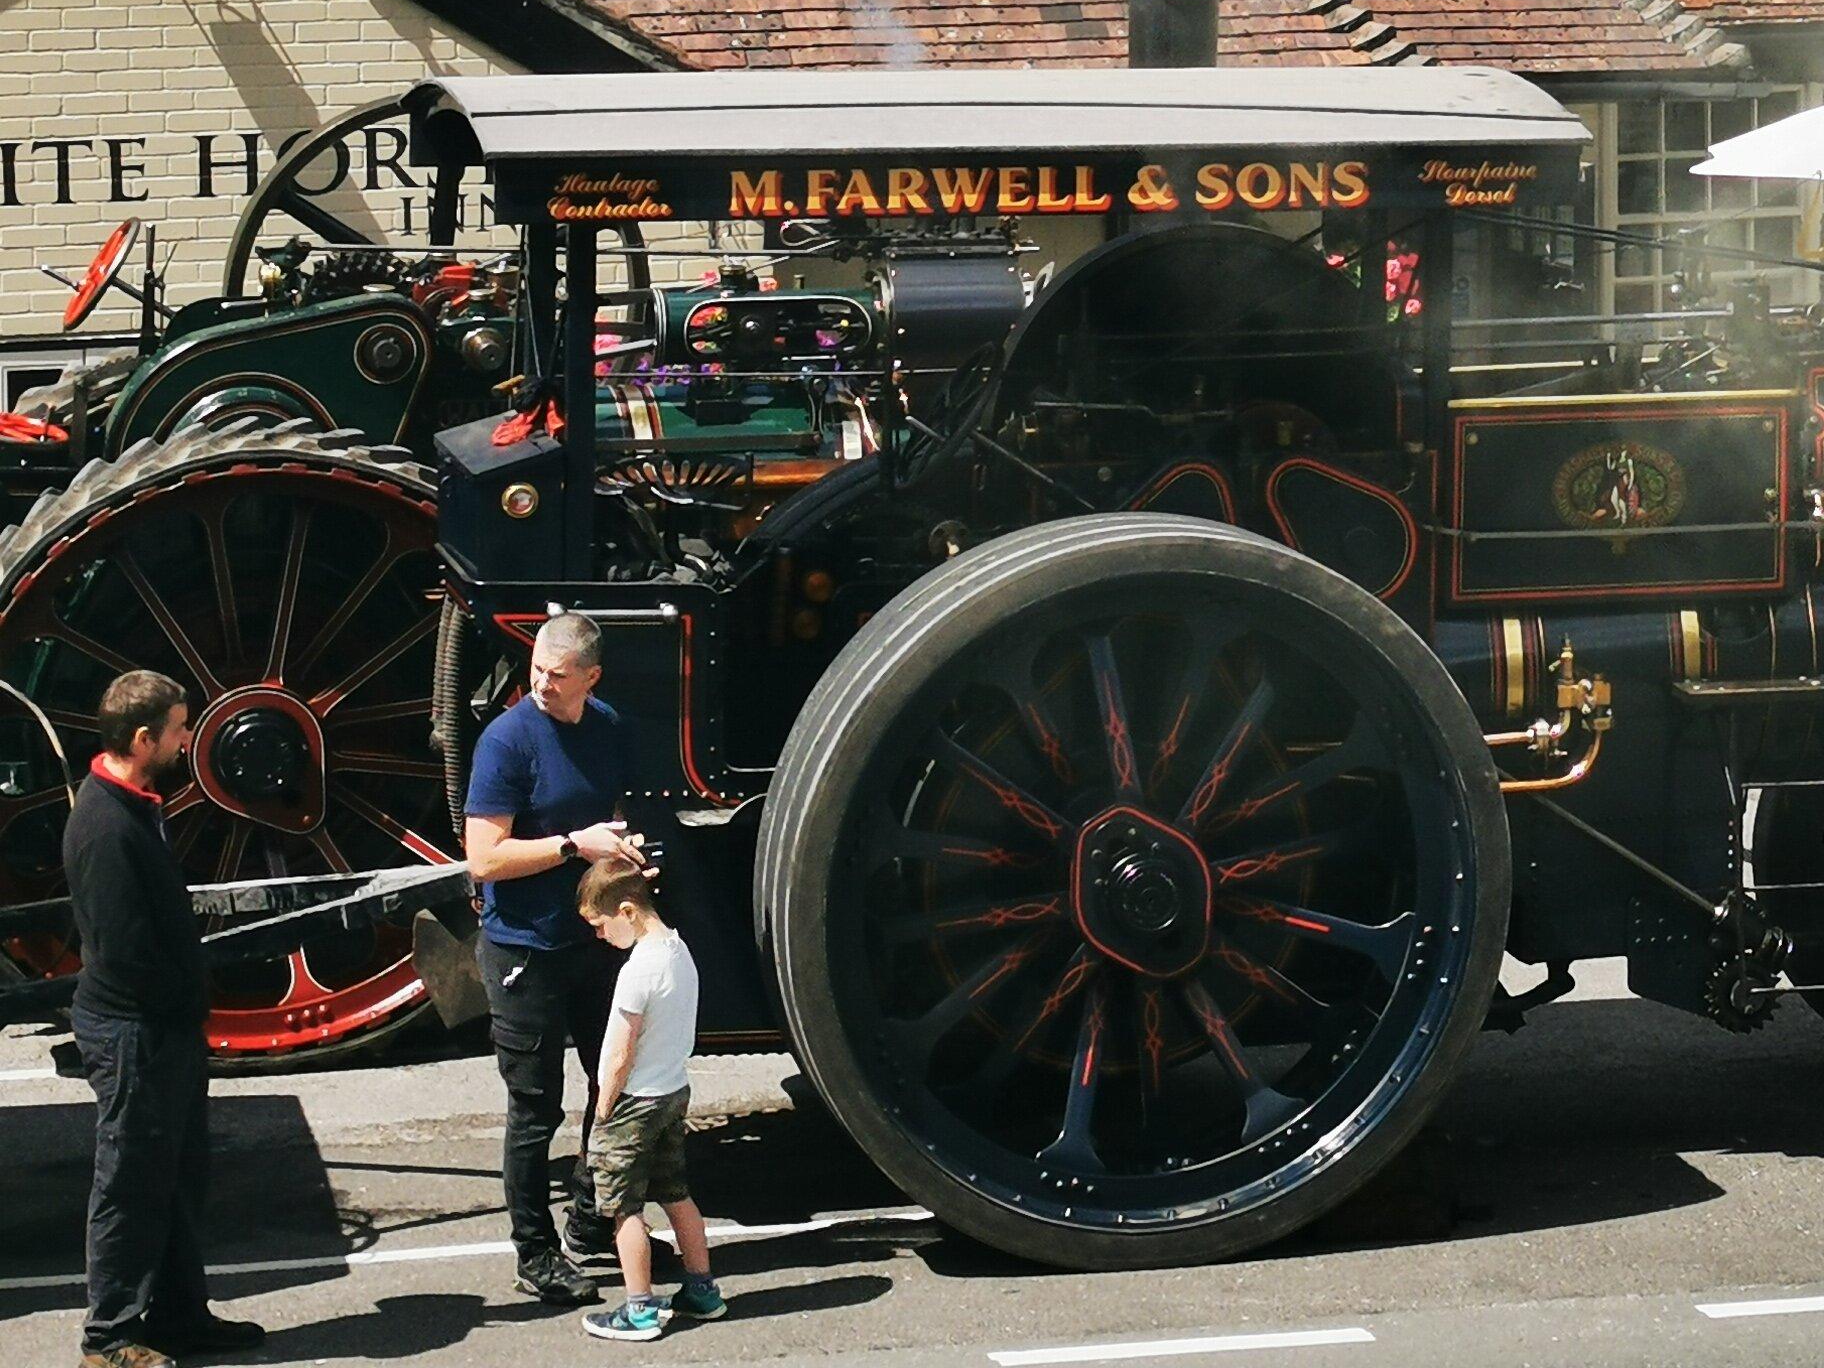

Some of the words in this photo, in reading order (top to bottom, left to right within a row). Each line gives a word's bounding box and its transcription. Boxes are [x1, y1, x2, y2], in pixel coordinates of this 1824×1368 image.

[198, 126, 496, 198] HOR
[553, 172, 660, 201] Haulage
[1127, 164, 1180, 212] &
[1195, 161, 1371, 211] SONS
[1444, 182, 1519, 208] Dorset
[546, 195, 673, 220] Contractor
